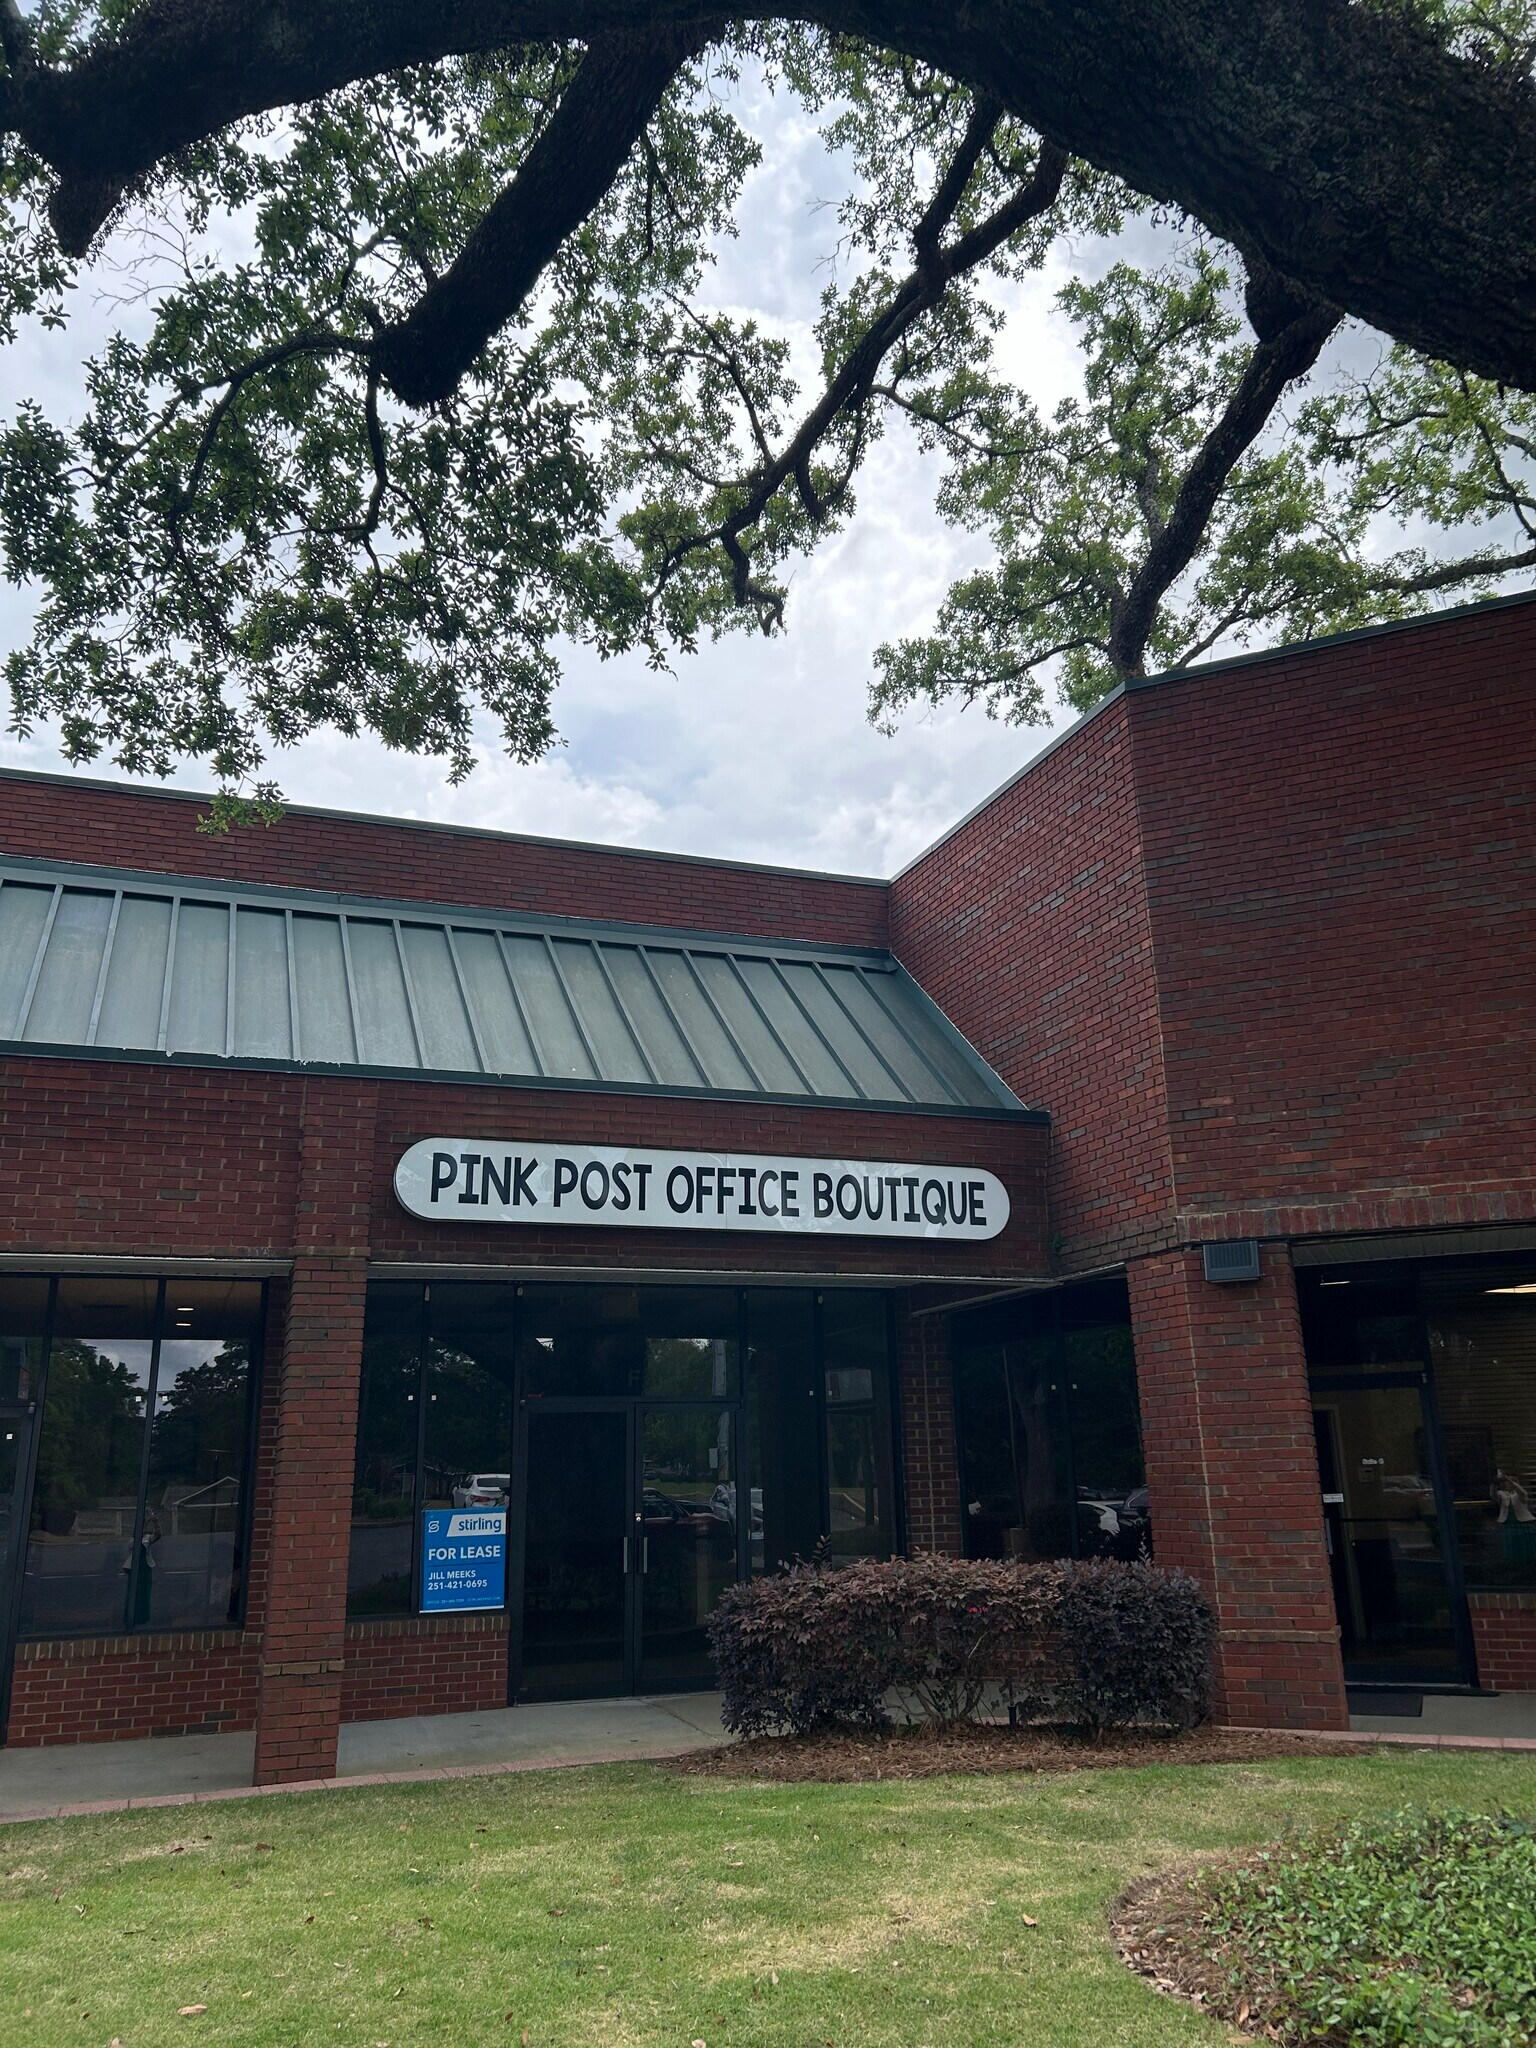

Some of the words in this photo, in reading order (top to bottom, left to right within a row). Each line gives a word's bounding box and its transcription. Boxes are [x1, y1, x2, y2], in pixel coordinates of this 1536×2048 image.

[430, 1152, 539, 1206] PINK
[553, 1158, 652, 1211] POST
[666, 1165, 800, 1217] OFFICE
[813, 1172, 987, 1226] BOUTIQUE
[458, 1517, 502, 1533] stirling
[428, 1547, 457, 1561] FOR
[460, 1545, 501, 1559] LEASE
[428, 1572, 445, 1580] JILL
[446, 1569, 476, 1580] MEEKS
[427, 1579, 488, 1591] 251-421-0695
